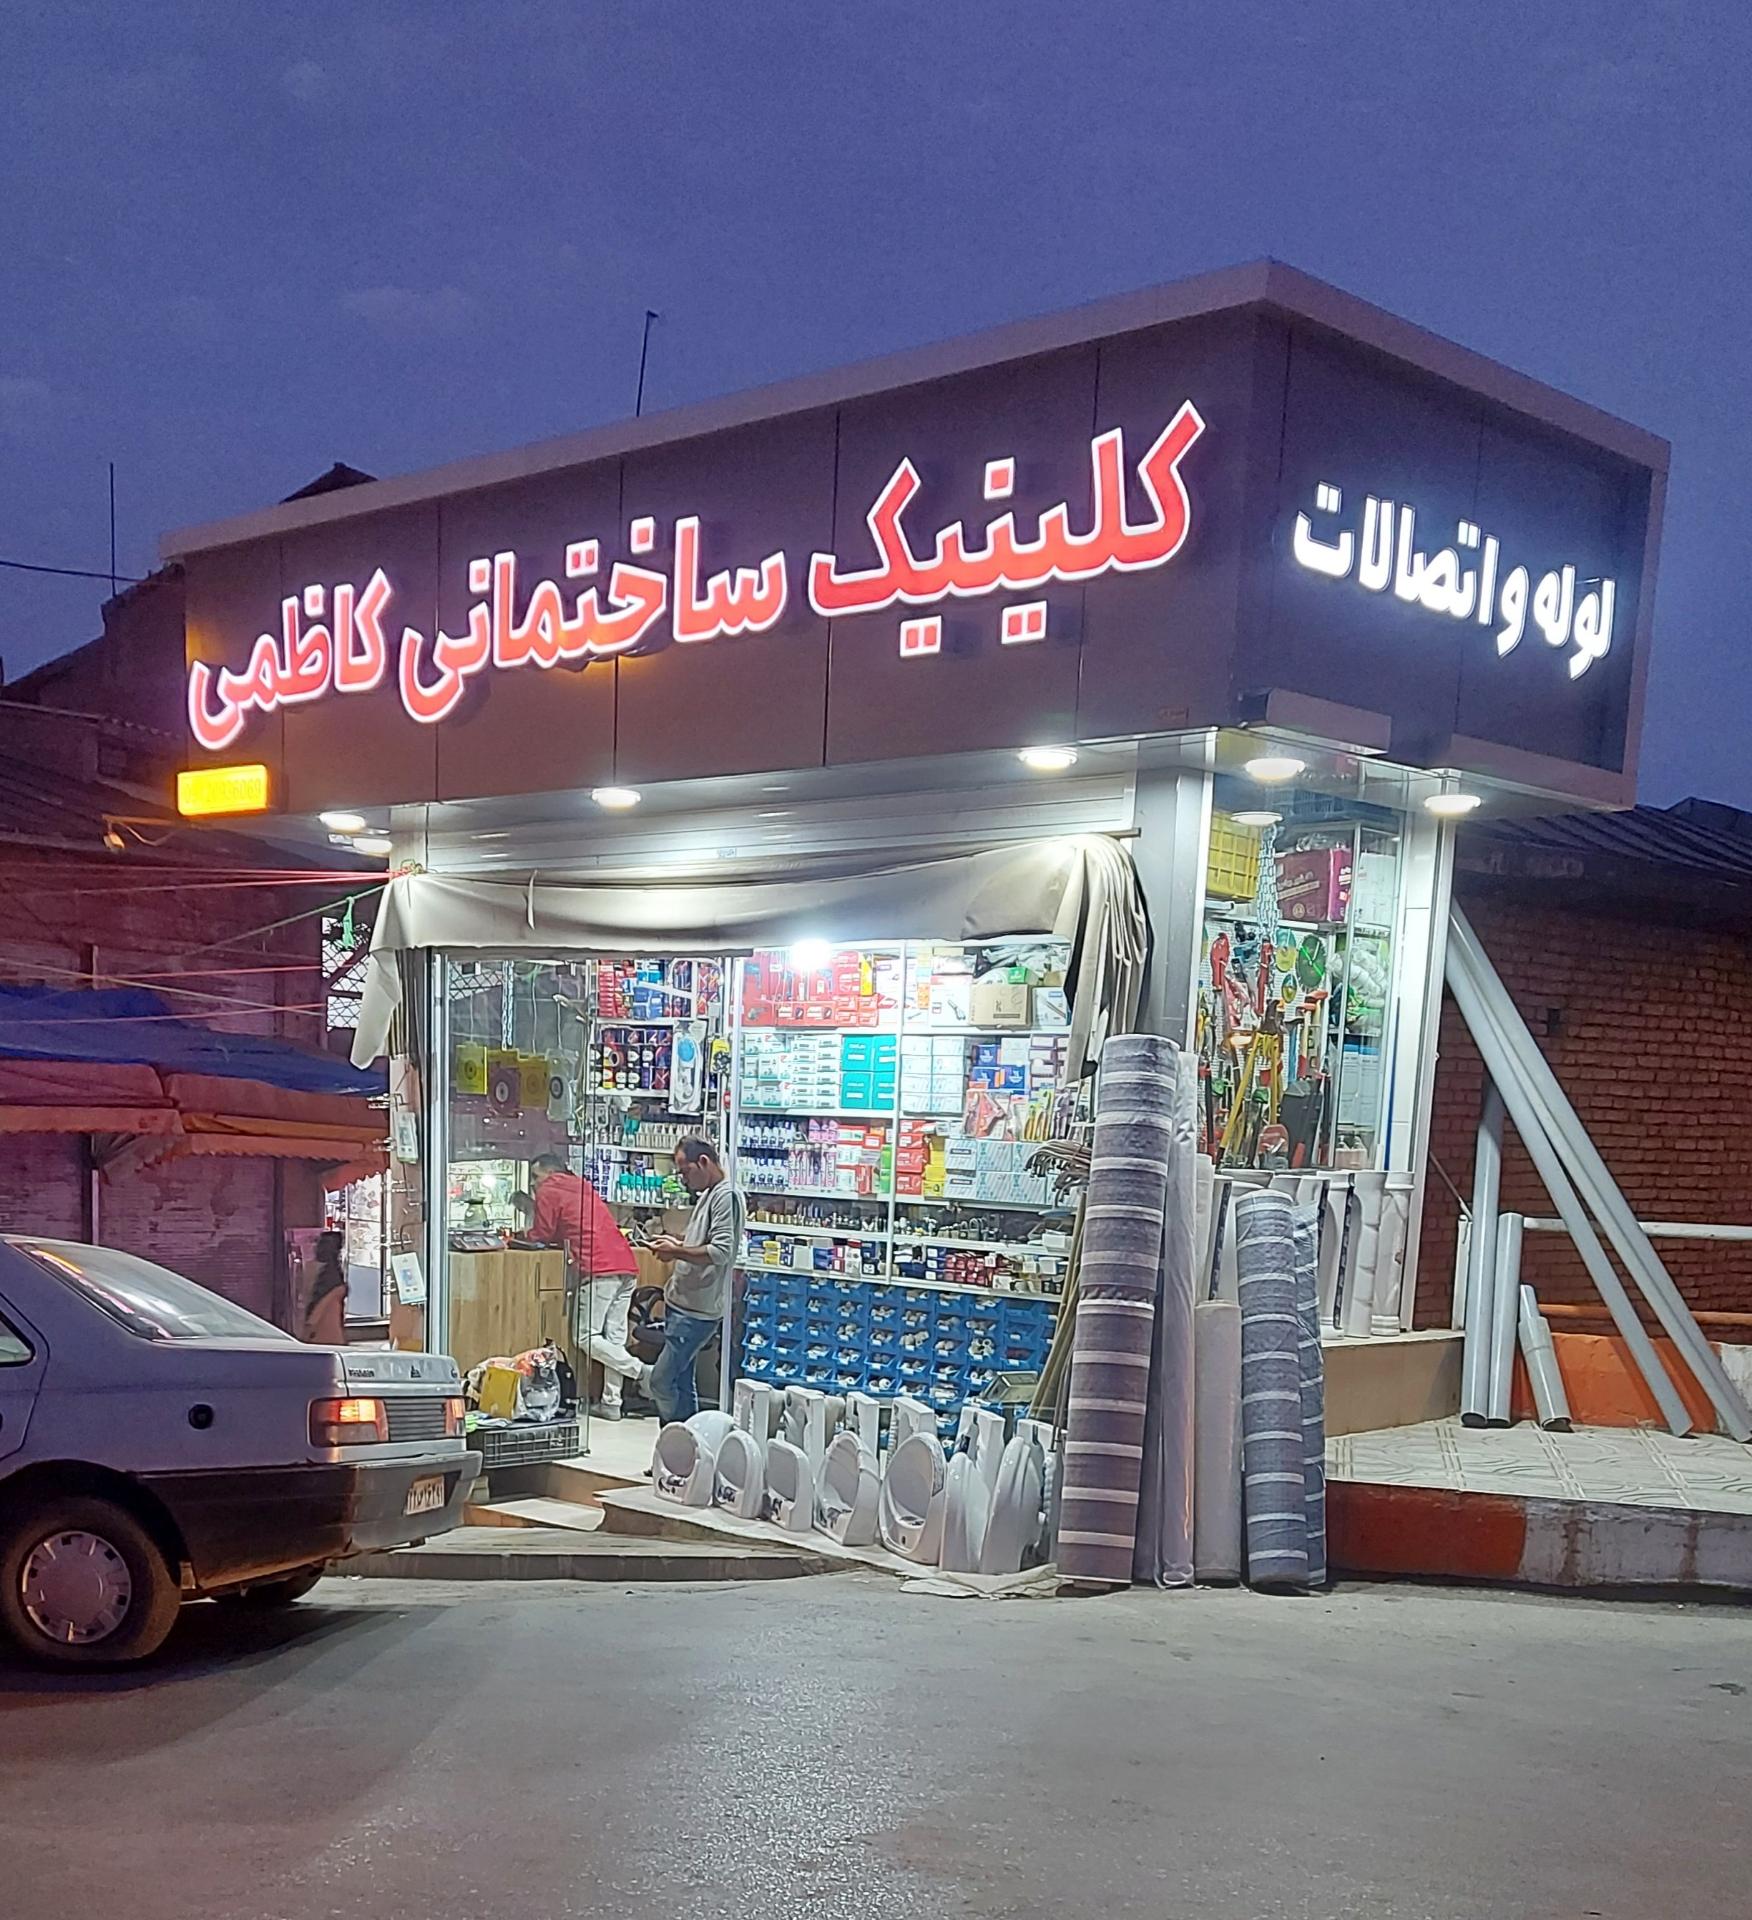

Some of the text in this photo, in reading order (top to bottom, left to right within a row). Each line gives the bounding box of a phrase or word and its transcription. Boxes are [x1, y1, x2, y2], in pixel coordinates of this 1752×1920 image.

[188, 400, 1206, 750] کلینیک ساختمانی کاظمی
[1293, 480, 1616, 680] لوله و اتصالات
